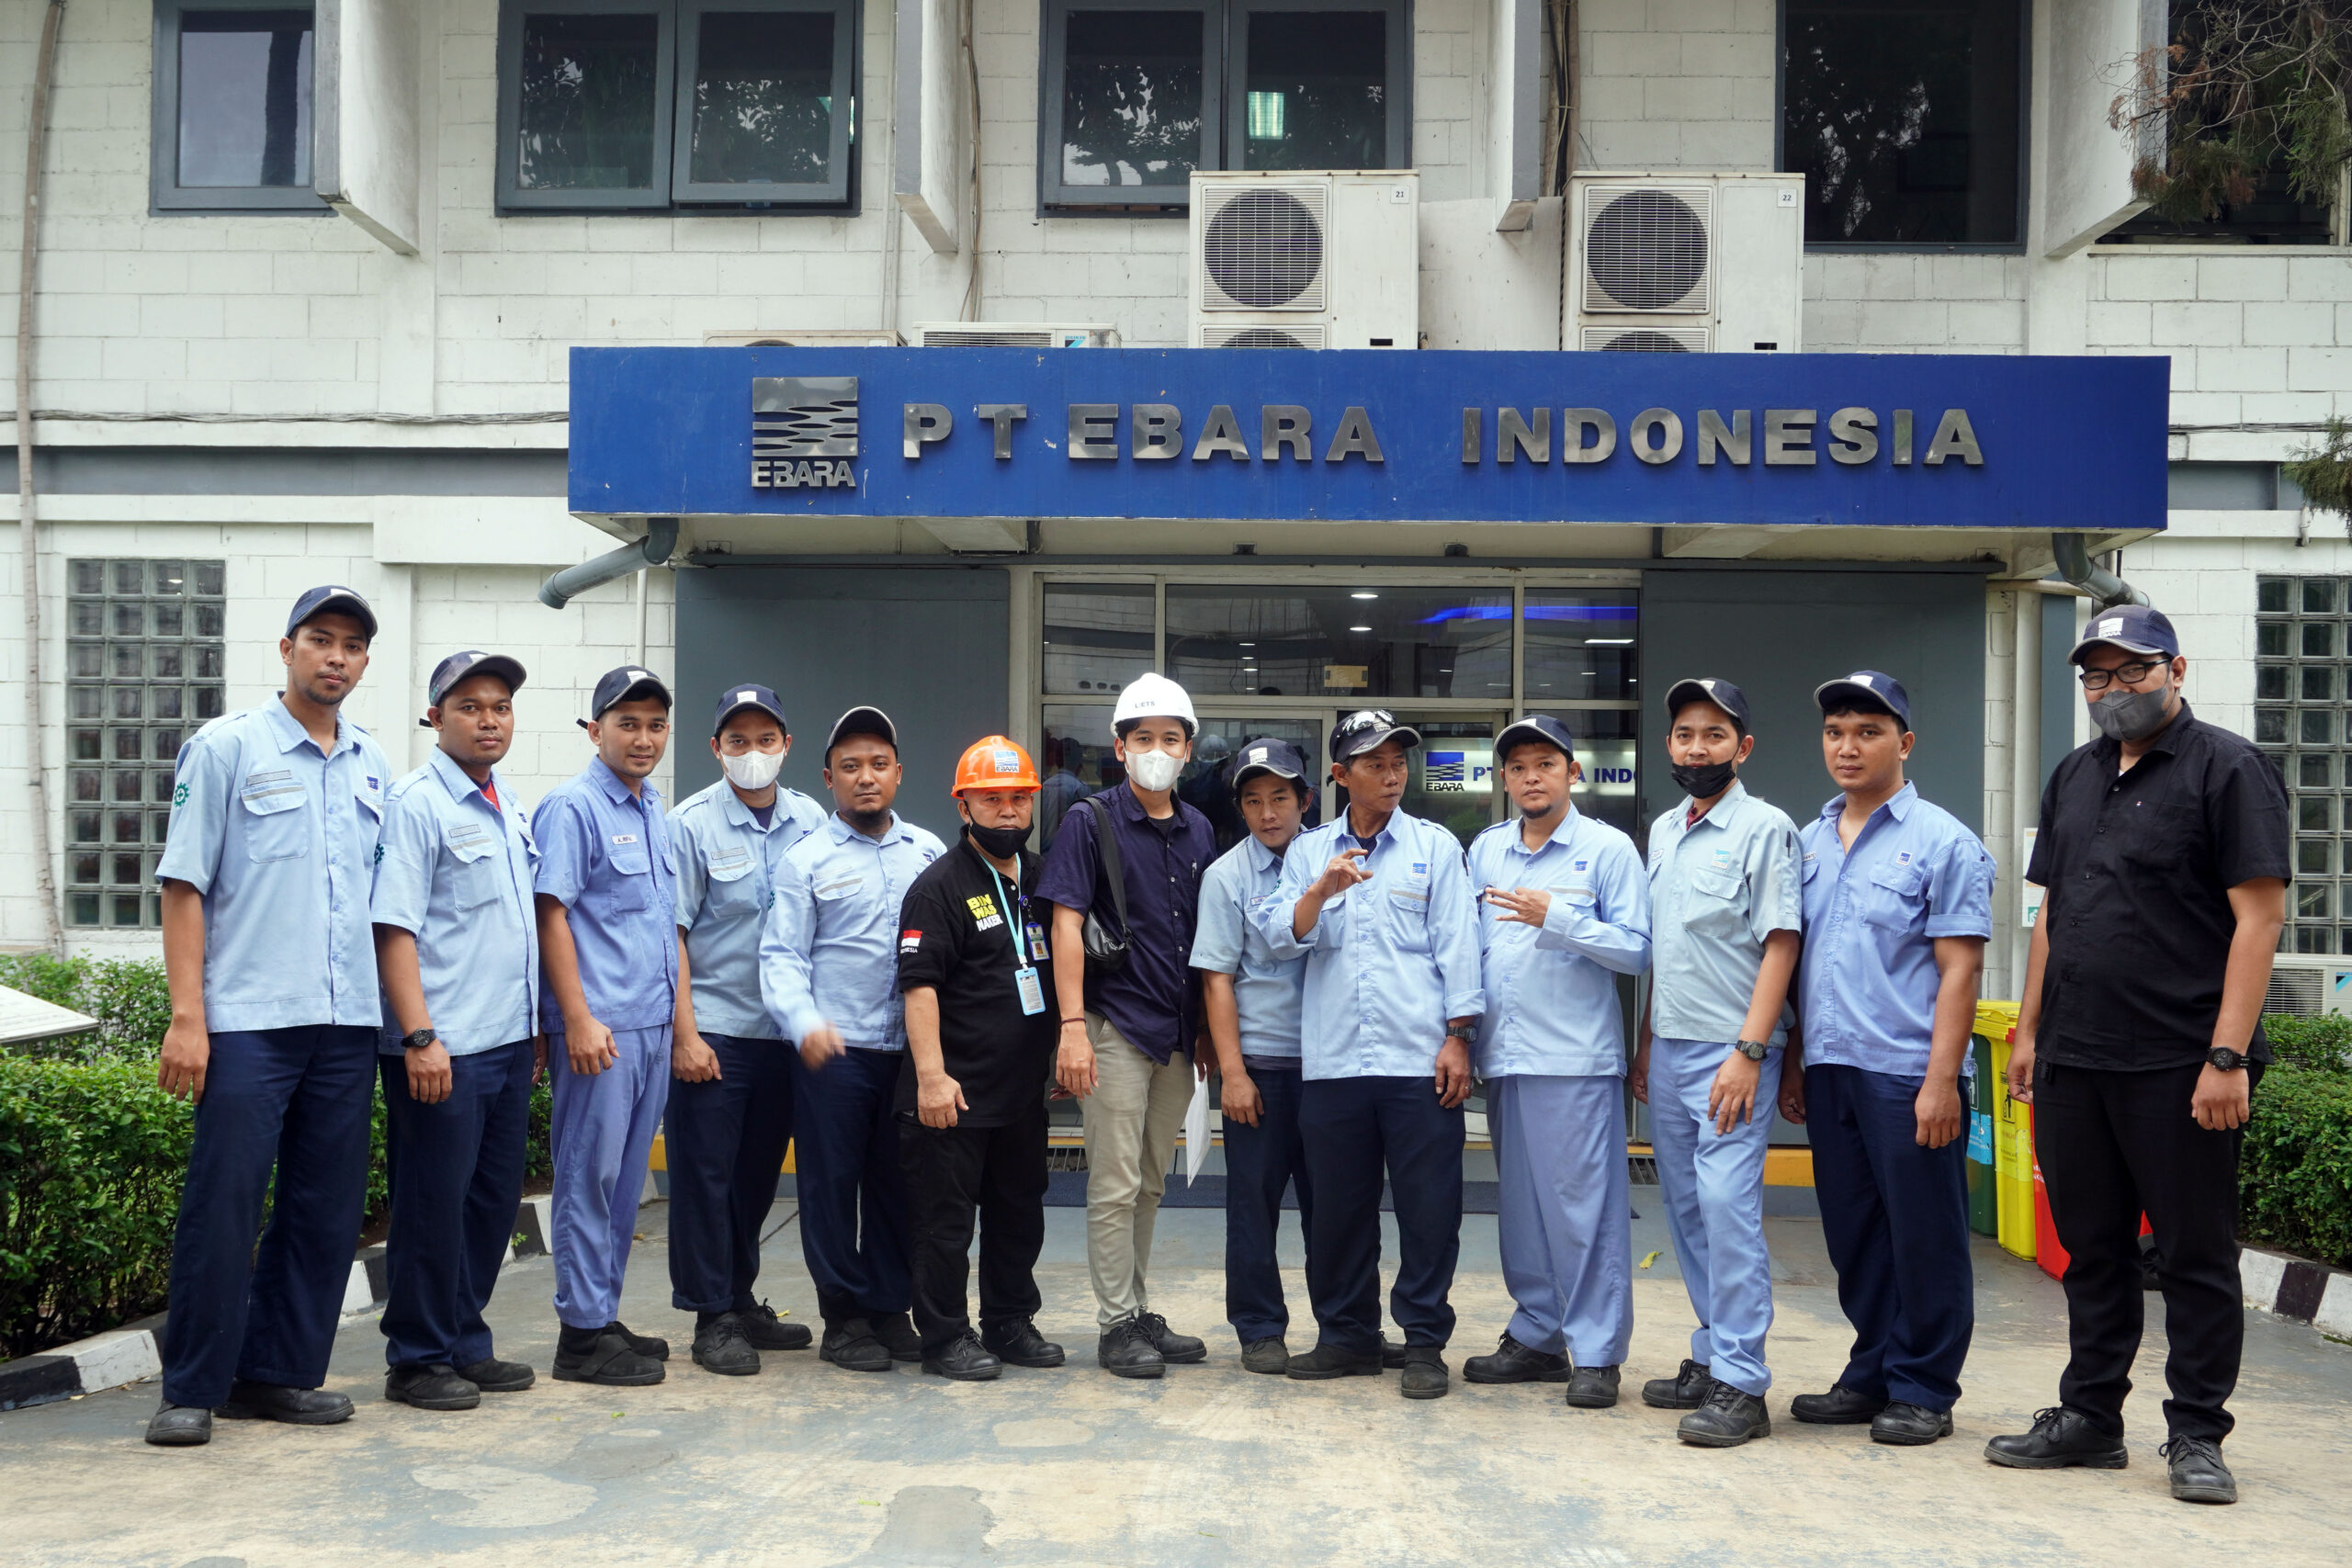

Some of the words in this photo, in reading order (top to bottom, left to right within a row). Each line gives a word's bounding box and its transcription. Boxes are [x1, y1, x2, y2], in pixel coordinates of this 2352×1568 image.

[1396, 190, 1404, 198] 21
[904, 403, 1027, 458] PT
[1069, 404, 1385, 461] EBARA
[1463, 406, 1984, 465] INDONESIA
[752, 460, 856, 488] EBARA
[1594, 767, 1636, 784] IND
[1426, 782, 1464, 792] EBARA
[967, 894, 992, 910] BIN
[972, 904, 997, 919] WAS
[976, 914, 1003, 931] NAKER
